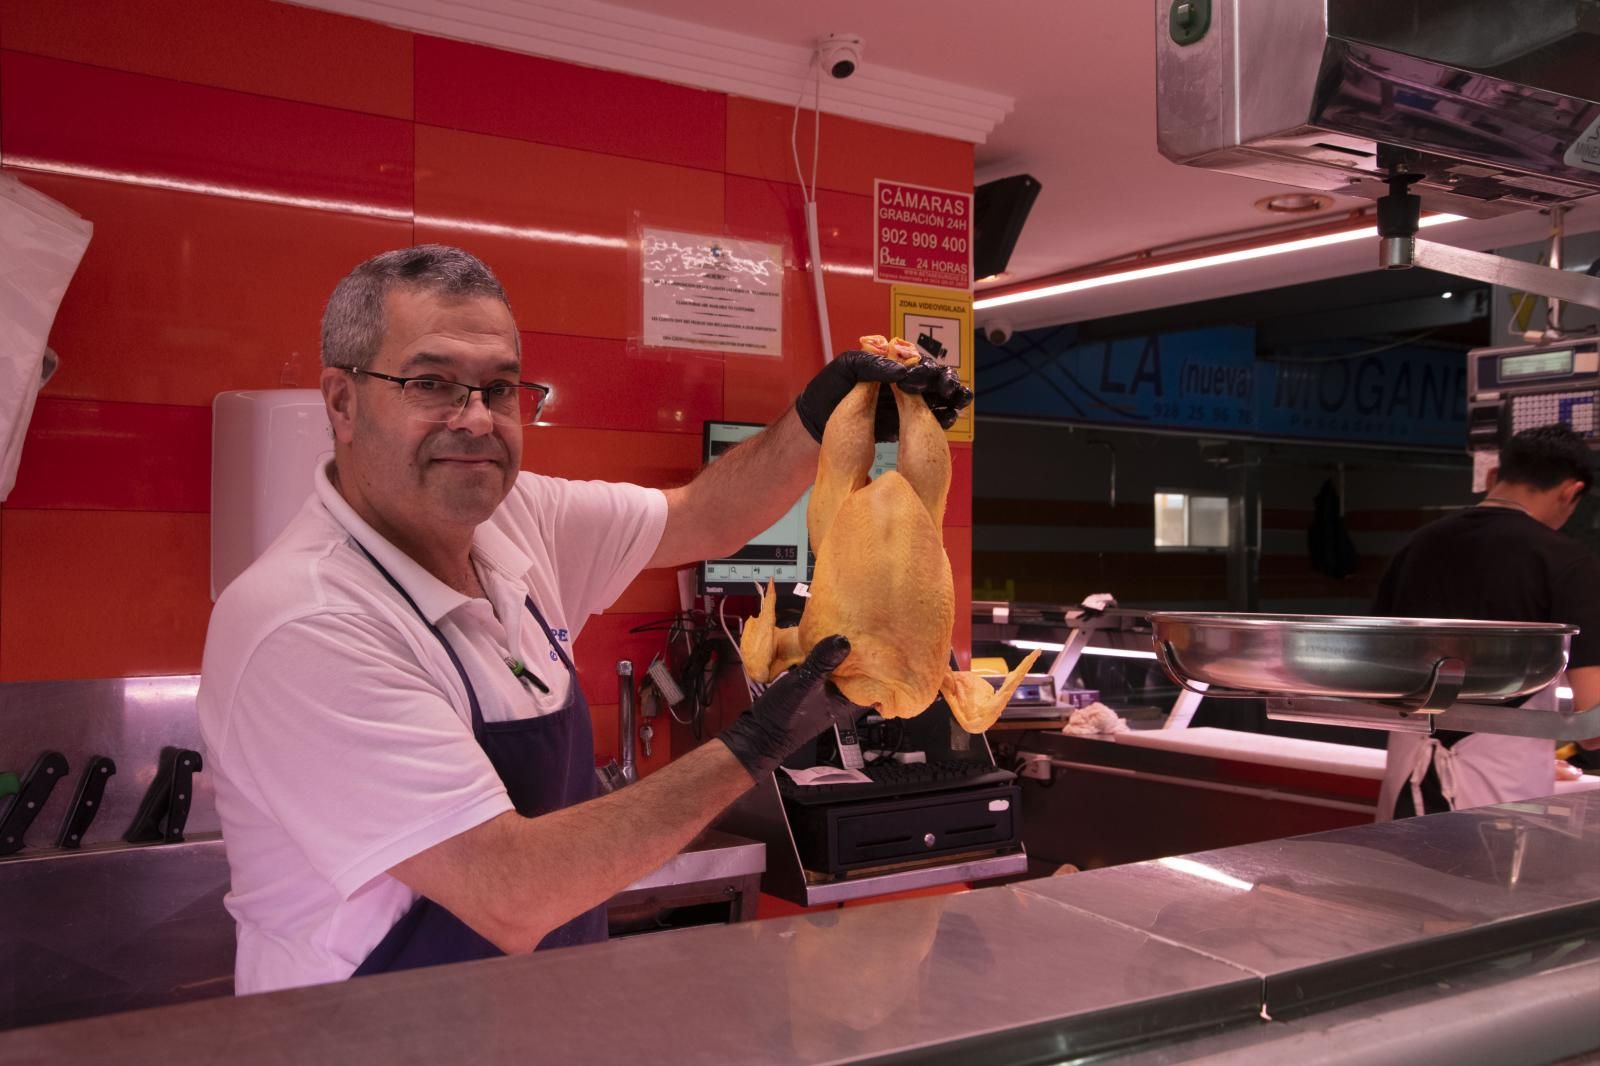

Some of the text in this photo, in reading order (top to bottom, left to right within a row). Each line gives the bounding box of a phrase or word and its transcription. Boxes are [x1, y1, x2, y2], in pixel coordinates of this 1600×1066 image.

[880, 187, 965, 216] CÁMARAS
[879, 207, 967, 231] GRABACIÓN 24H
[881, 226, 967, 253] 902 909 400
[916, 257, 929, 269] 24
[931, 260, 968, 274] HORAS
[899, 300, 966, 313] ZONA VIDEOVIGILADA
